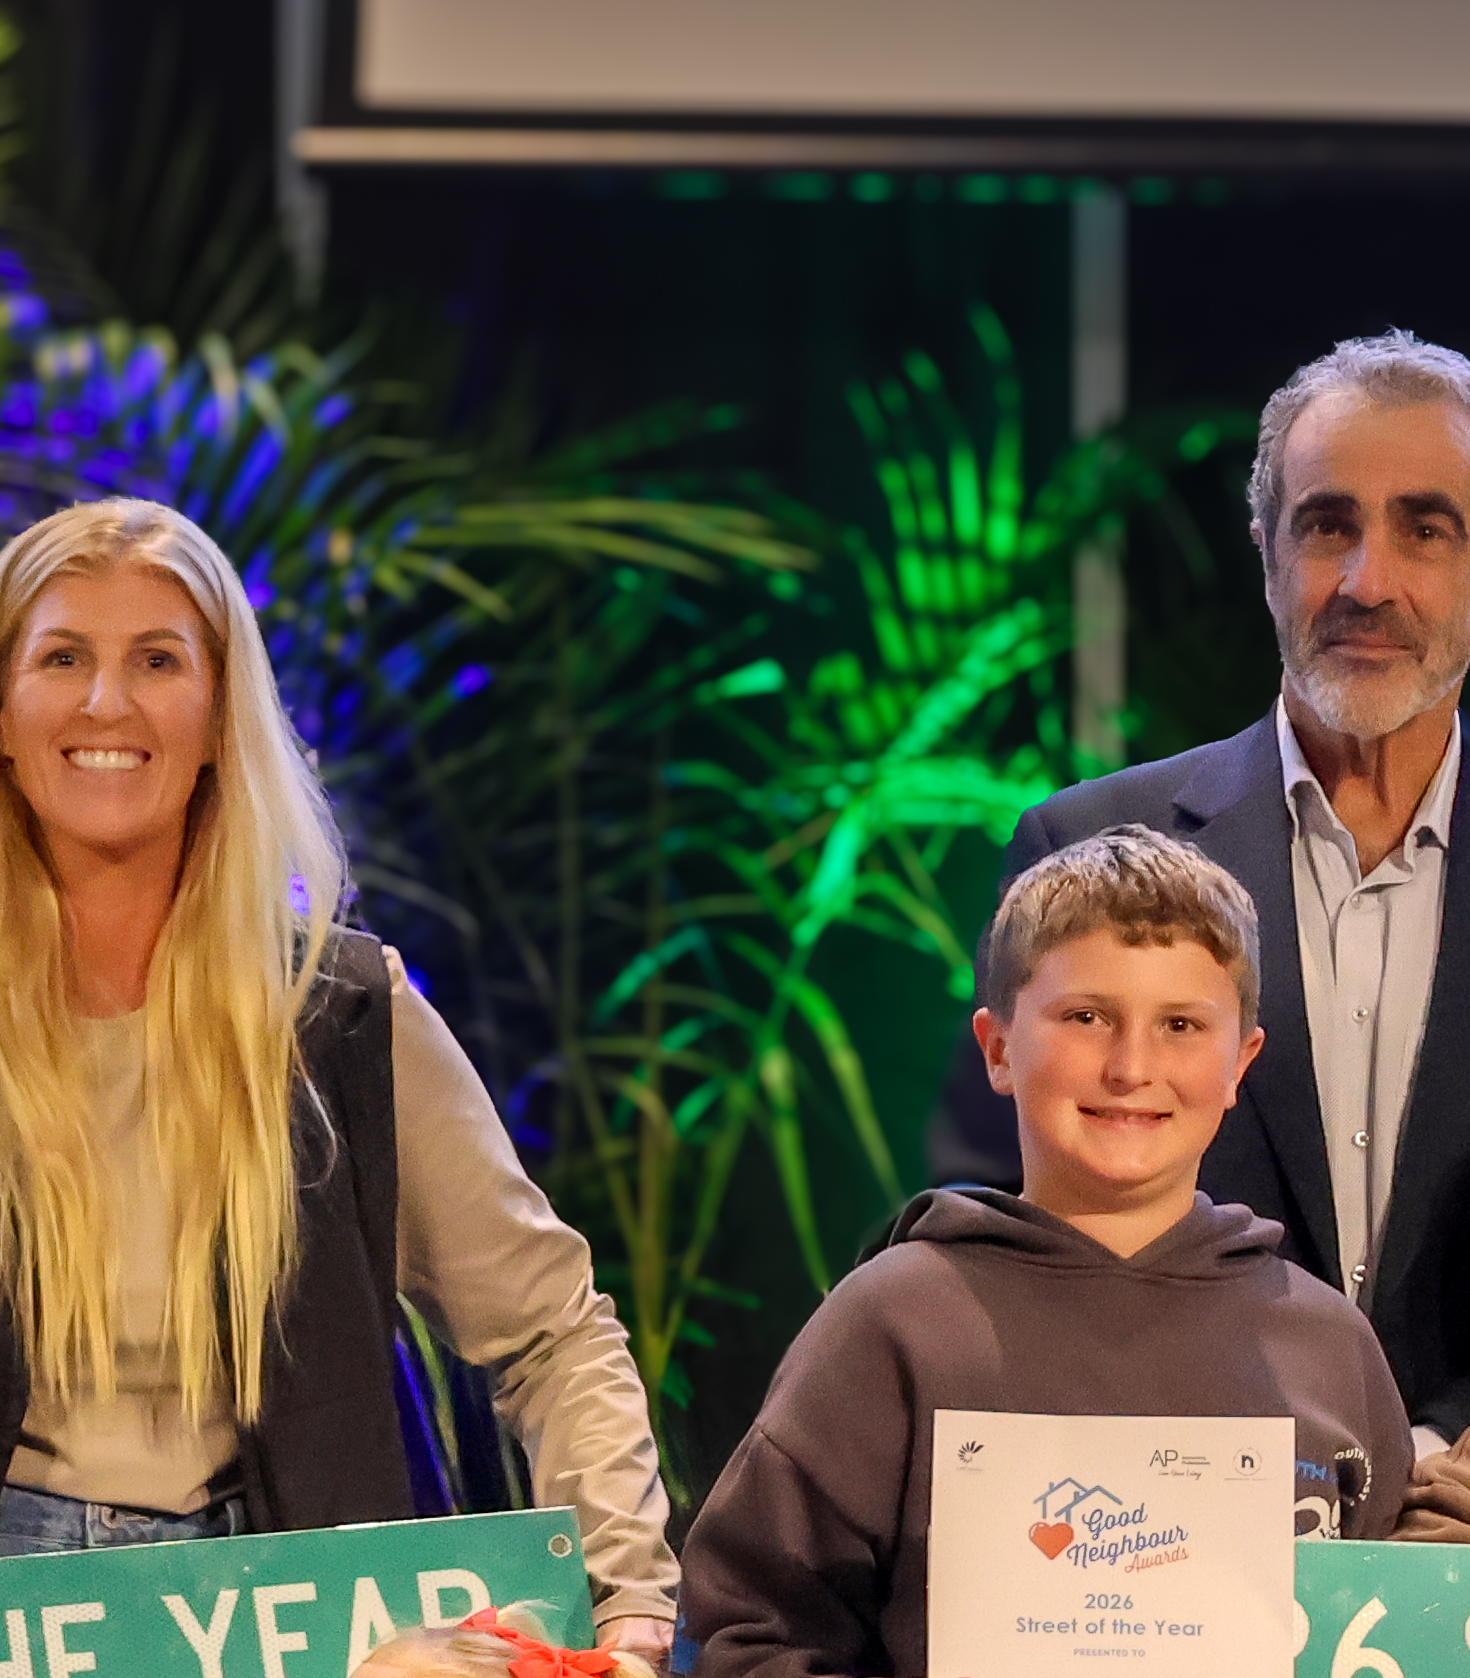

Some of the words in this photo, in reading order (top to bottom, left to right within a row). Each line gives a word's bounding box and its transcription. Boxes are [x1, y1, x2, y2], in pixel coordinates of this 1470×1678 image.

[1082, 1502, 1148, 1540] Good
[1067, 1525, 1189, 1569] Neighbour
[1124, 1546, 1189, 1573] Awards
[1085, 1594, 1134, 1610] 2026
[1016, 1617, 1078, 1634] Street
[1086, 1618, 1106, 1635] of
[1112, 1618, 1145, 1635] the
[1155, 1620, 1204, 1637] Year
